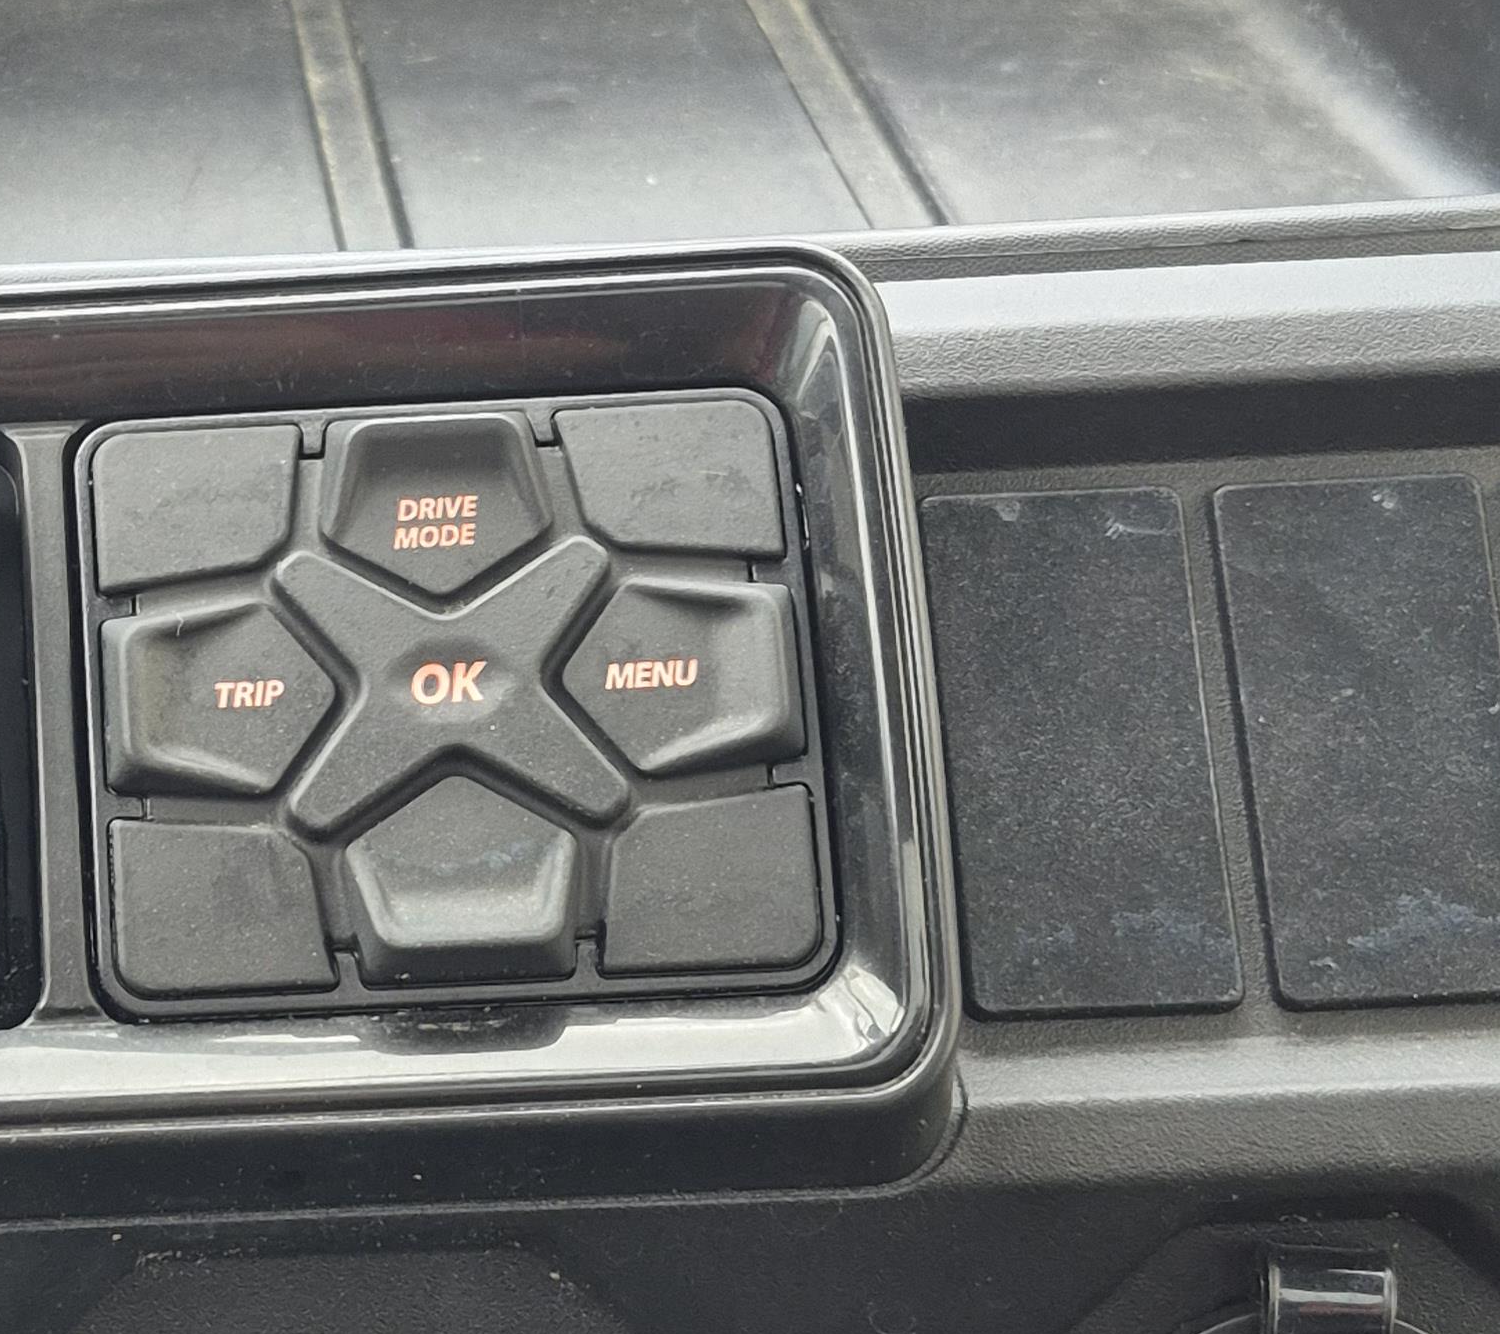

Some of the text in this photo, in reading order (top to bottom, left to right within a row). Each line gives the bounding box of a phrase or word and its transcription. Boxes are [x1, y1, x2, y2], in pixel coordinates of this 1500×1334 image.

[397, 495, 479, 522] DRIVE
[393, 523, 476, 550] MODE
[411, 659, 488, 706] OK
[605, 658, 699, 691] MENU
[214, 679, 285, 709] TRIP
